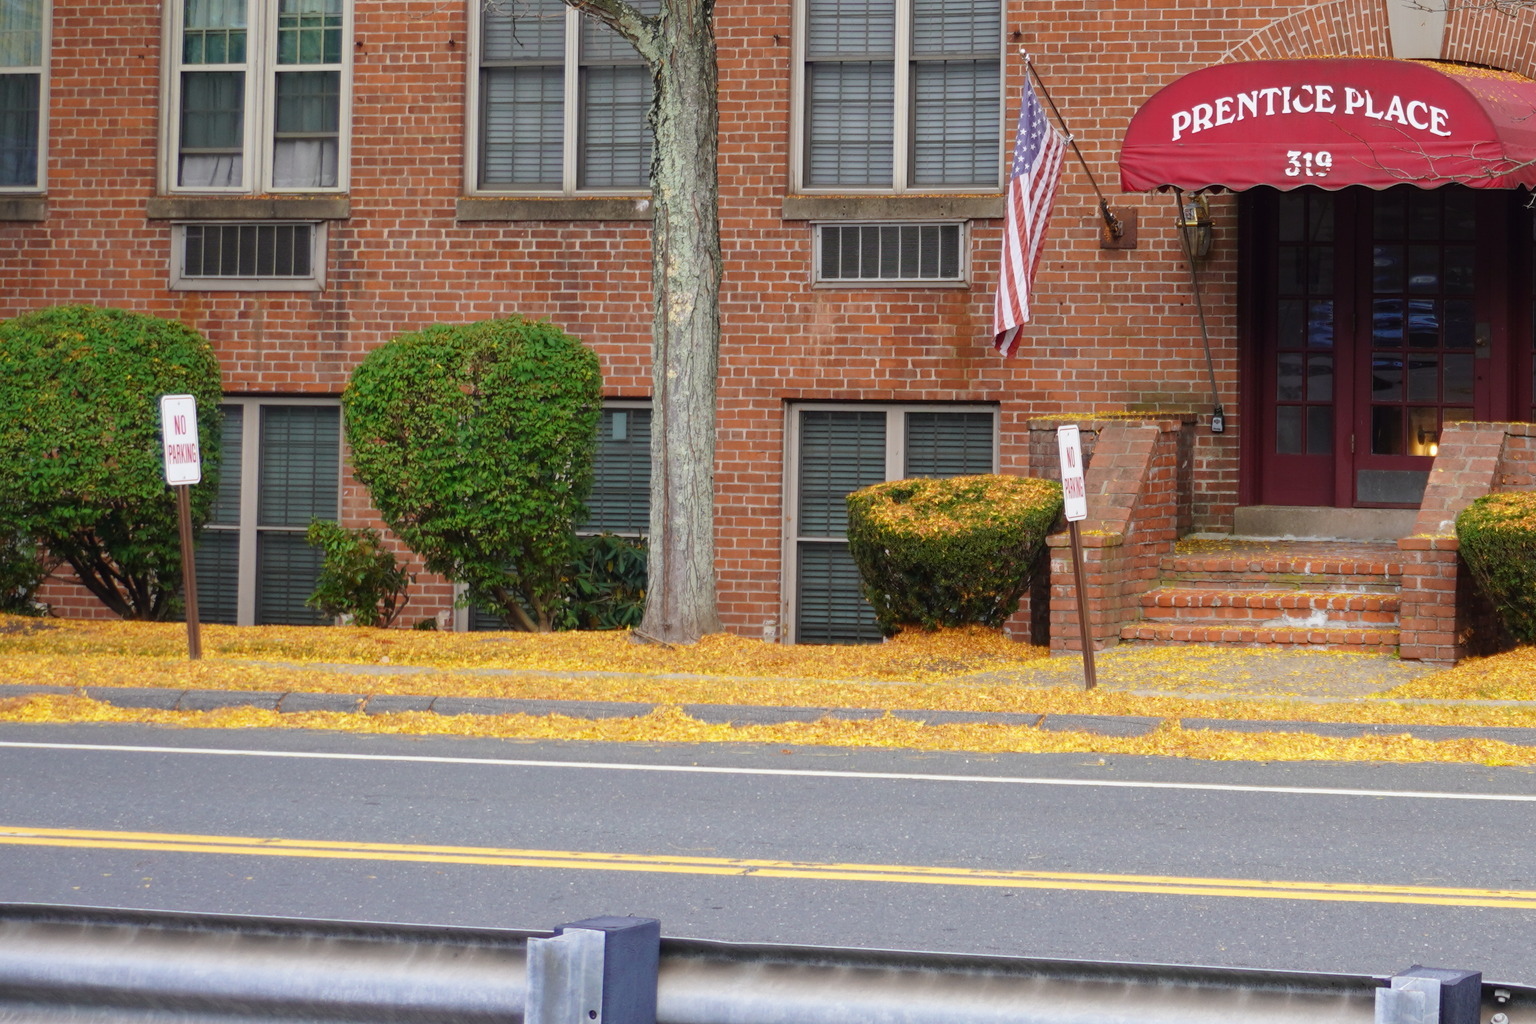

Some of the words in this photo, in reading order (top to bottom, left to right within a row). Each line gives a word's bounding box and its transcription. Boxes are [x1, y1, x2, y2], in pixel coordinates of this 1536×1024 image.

[1171, 84, 1337, 142] PRENTICE
[1344, 86, 1452, 137] PLACE
[1284, 150, 1333, 177] 319
[173, 415, 187, 435] NO
[168, 443, 197, 464] PARKING
